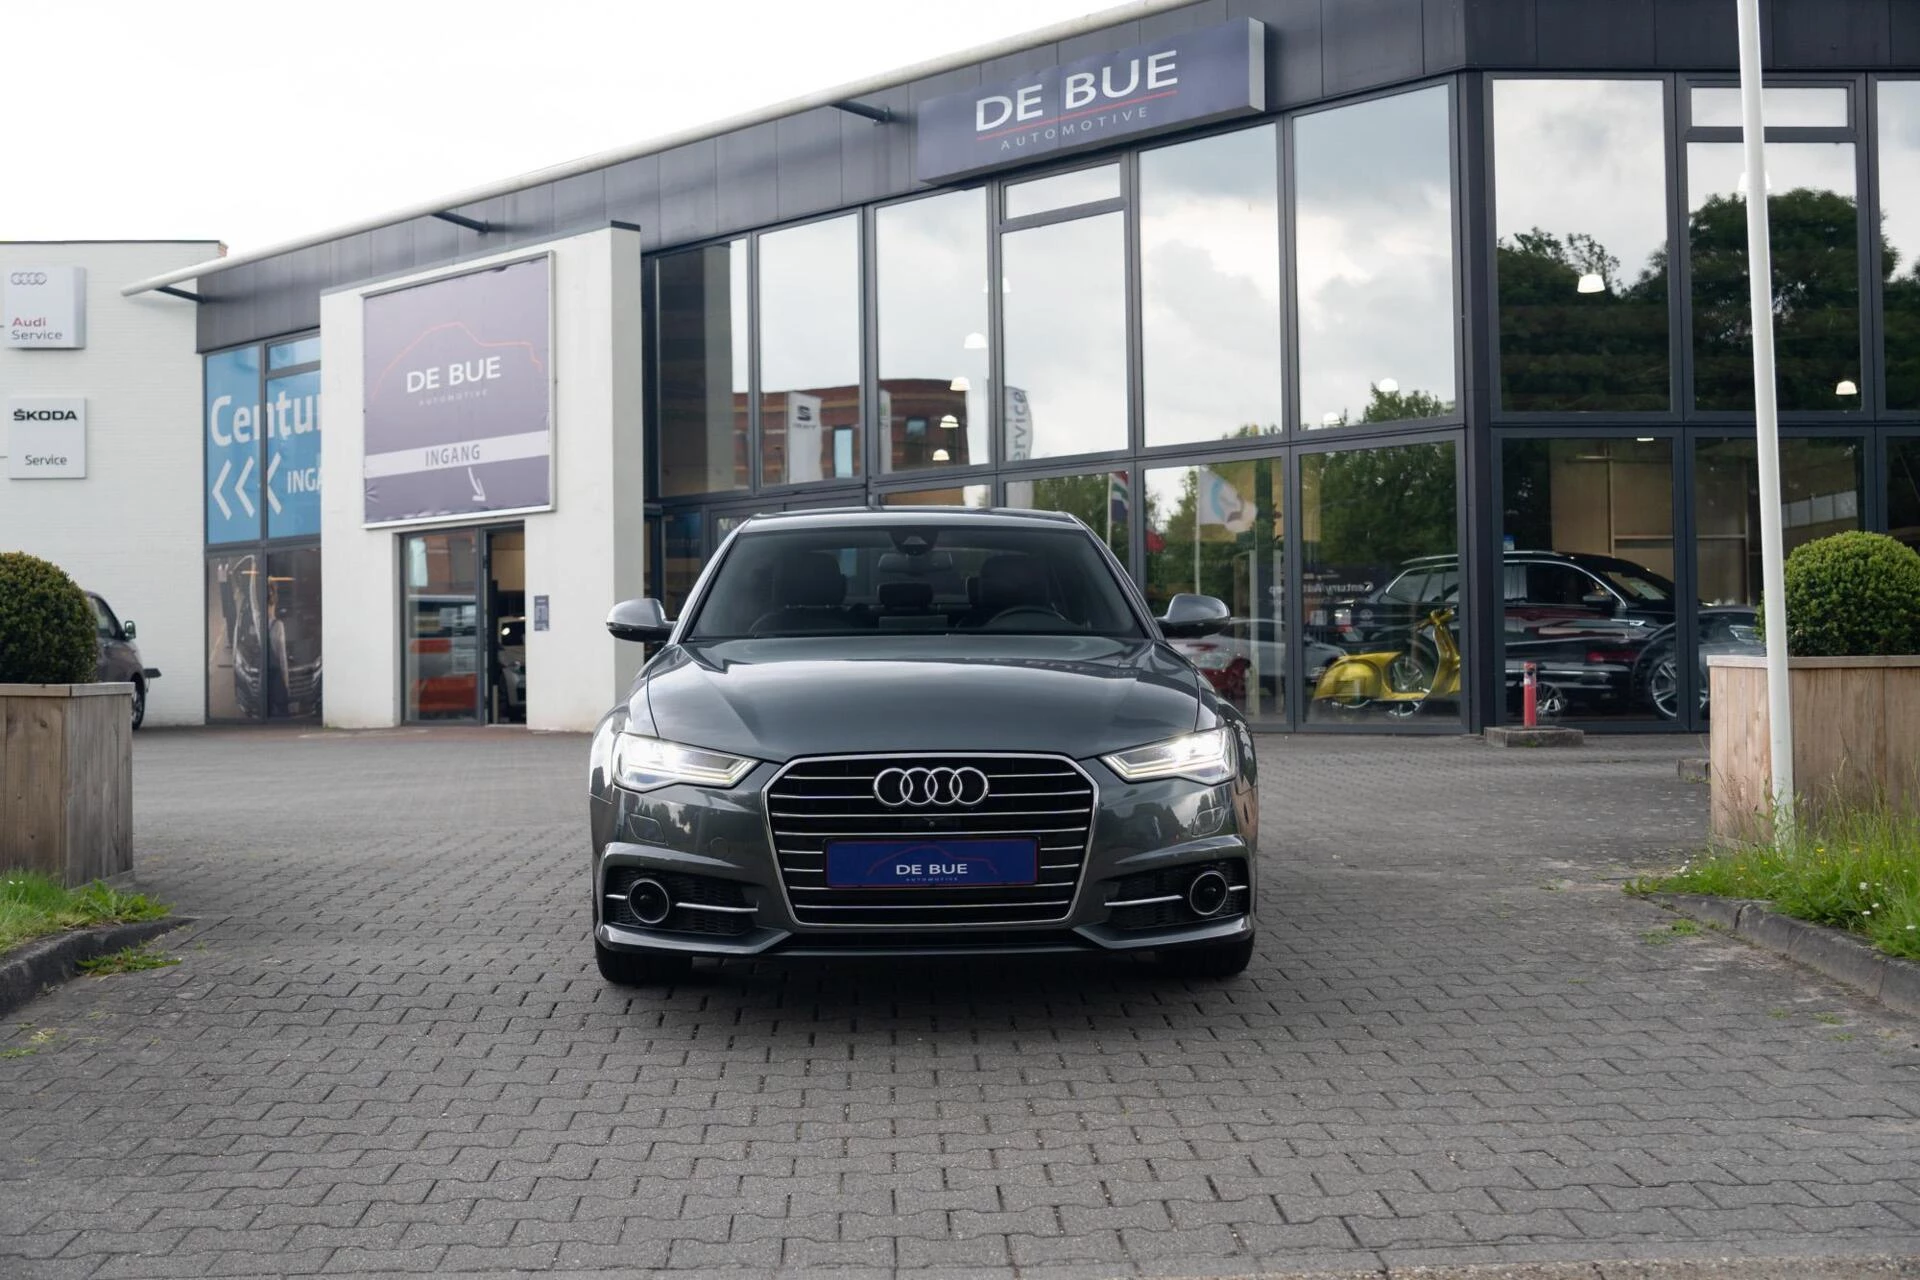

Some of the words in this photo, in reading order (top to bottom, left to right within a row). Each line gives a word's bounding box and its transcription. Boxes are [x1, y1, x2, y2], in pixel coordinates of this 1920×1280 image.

[976, 84, 1043, 132] DE
[1065, 50, 1178, 110] BUE
[1001, 107, 1148, 150] AUTOMOTIVE
[12, 317, 47, 327] Audi
[12, 330, 63, 340] Service
[407, 367, 440, 393] DE
[449, 356, 501, 386] BUE
[13, 408, 78, 421] ŠKODA
[25, 455, 67, 466] Service
[425, 444, 481, 467] INGANG
[896, 864, 922, 875] DE
[929, 864, 968, 874] BUE
